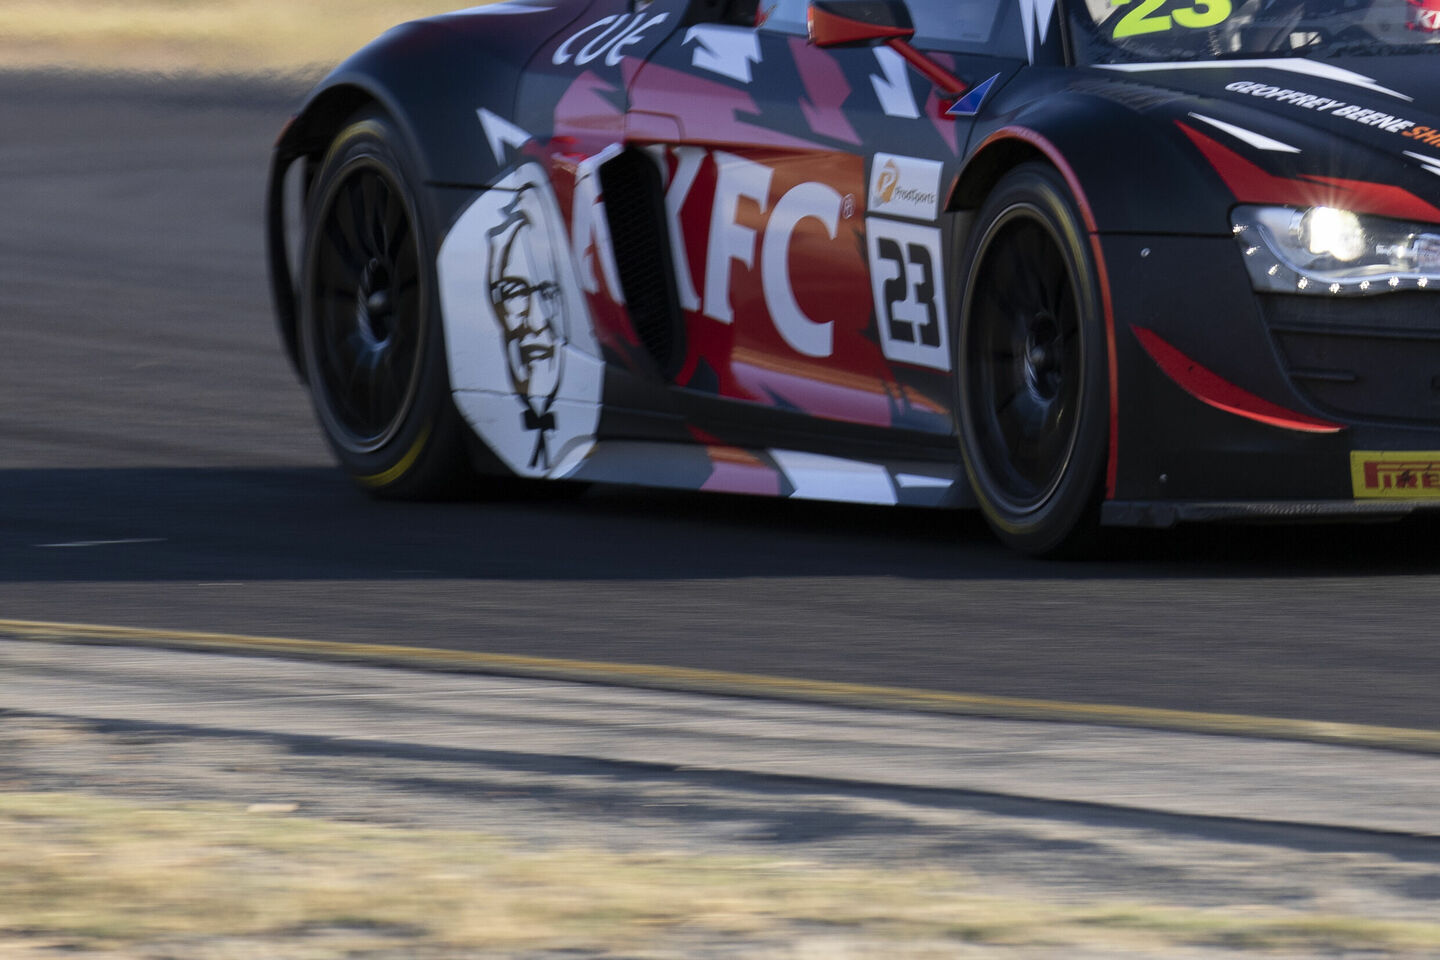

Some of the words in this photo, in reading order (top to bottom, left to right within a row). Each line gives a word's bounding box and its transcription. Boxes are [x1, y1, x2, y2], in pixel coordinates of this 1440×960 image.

[552, 11, 670, 67] CUE
[1225, 81, 1346, 112] GEOFFREY
[1332, 105, 1416, 133] BEENE
[876, 237, 941, 348] 23
